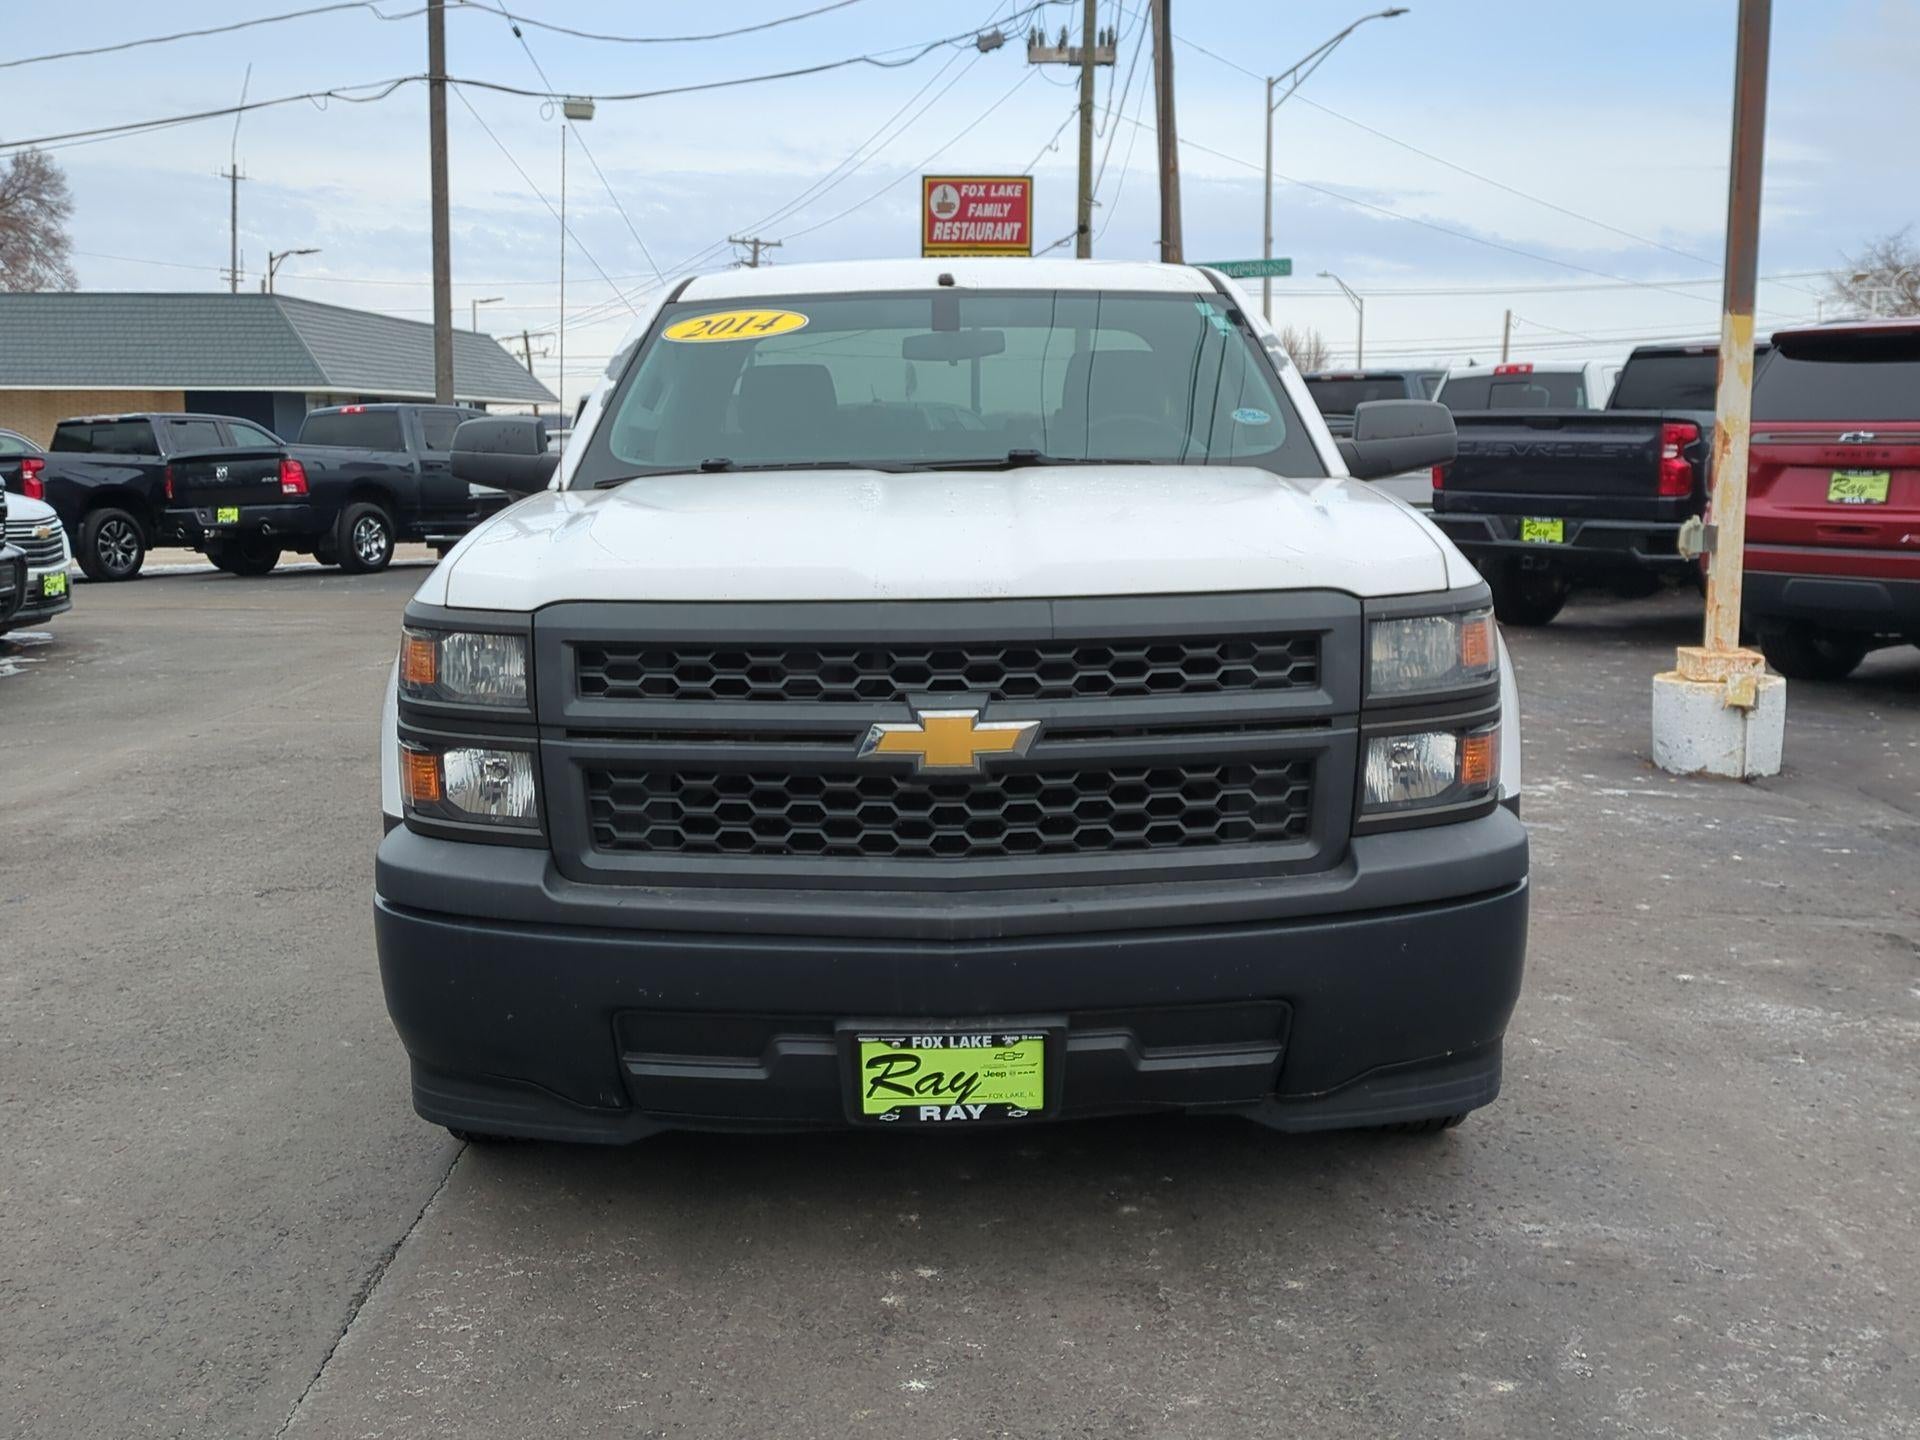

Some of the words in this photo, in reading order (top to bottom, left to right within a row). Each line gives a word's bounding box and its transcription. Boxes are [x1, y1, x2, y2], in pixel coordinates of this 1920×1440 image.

[961, 184, 986, 197] FOX
[990, 185, 1023, 197] LAKE
[967, 203, 1012, 217] FAMILY
[932, 222, 1022, 240] RESTAURANT
[681, 313, 786, 338] 2014
[1525, 523, 1550, 537] Ray
[912, 1036, 944, 1048] FOX
[950, 1036, 992, 1048] LAKE
[866, 1053, 982, 1104] Ray
[983, 1070, 1007, 1079] Jeep
[919, 1105, 987, 1121] RAY
